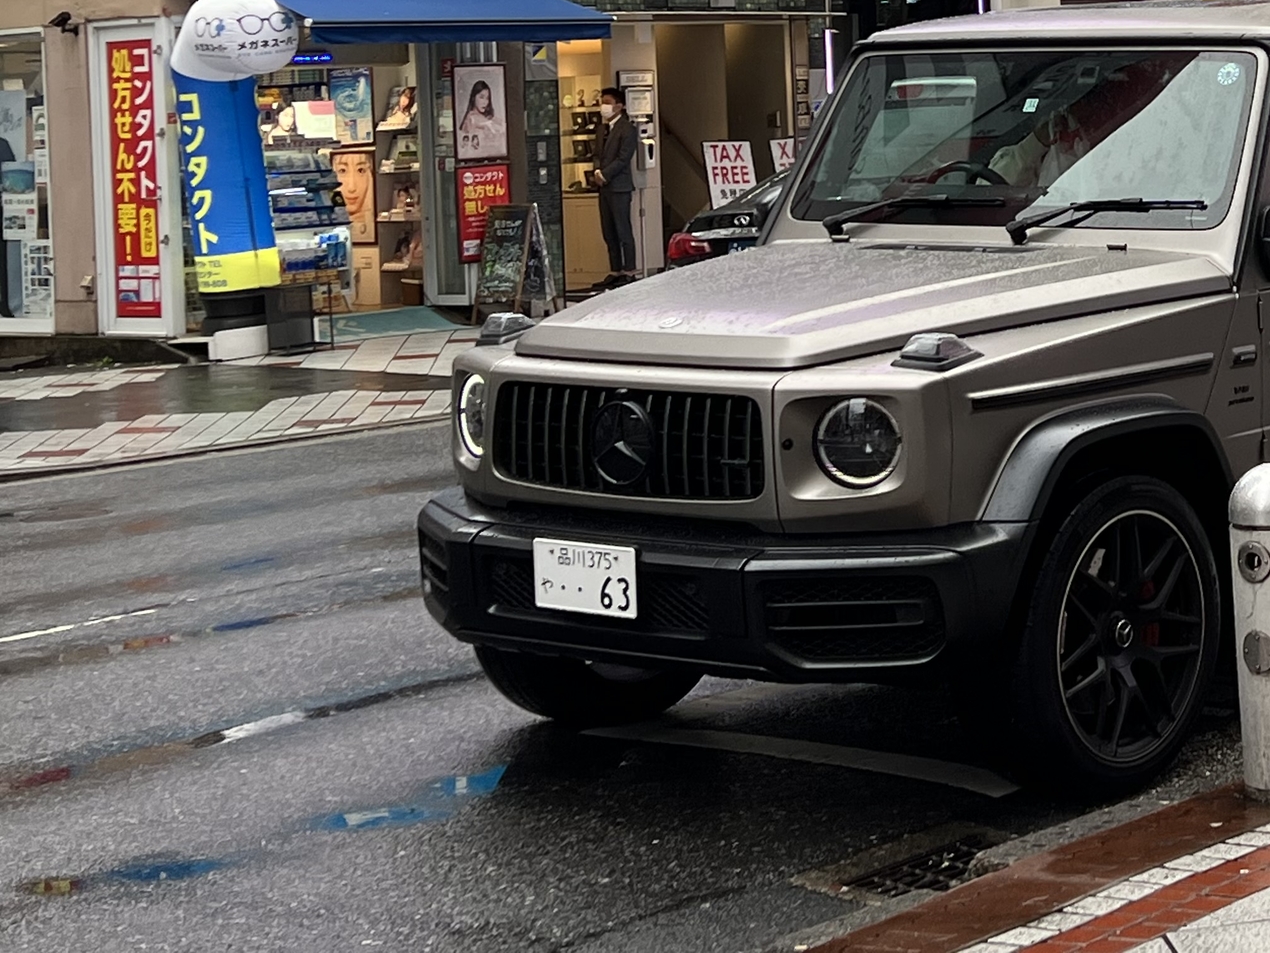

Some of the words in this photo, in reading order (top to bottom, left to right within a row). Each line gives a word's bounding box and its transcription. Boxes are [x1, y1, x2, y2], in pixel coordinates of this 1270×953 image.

[237, 36, 298, 51] メガネスーパー
[132, 48, 155, 199] コンタクト
[111, 49, 138, 262] 処方せん不要!
[709, 144, 745, 163] TAX
[179, 93, 219, 254] コンタクト
[474, 170, 504, 183] コンタクト
[711, 165, 751, 185] FREE
[463, 184, 506, 200] 処方せん
[600, 576, 630, 612] 63
